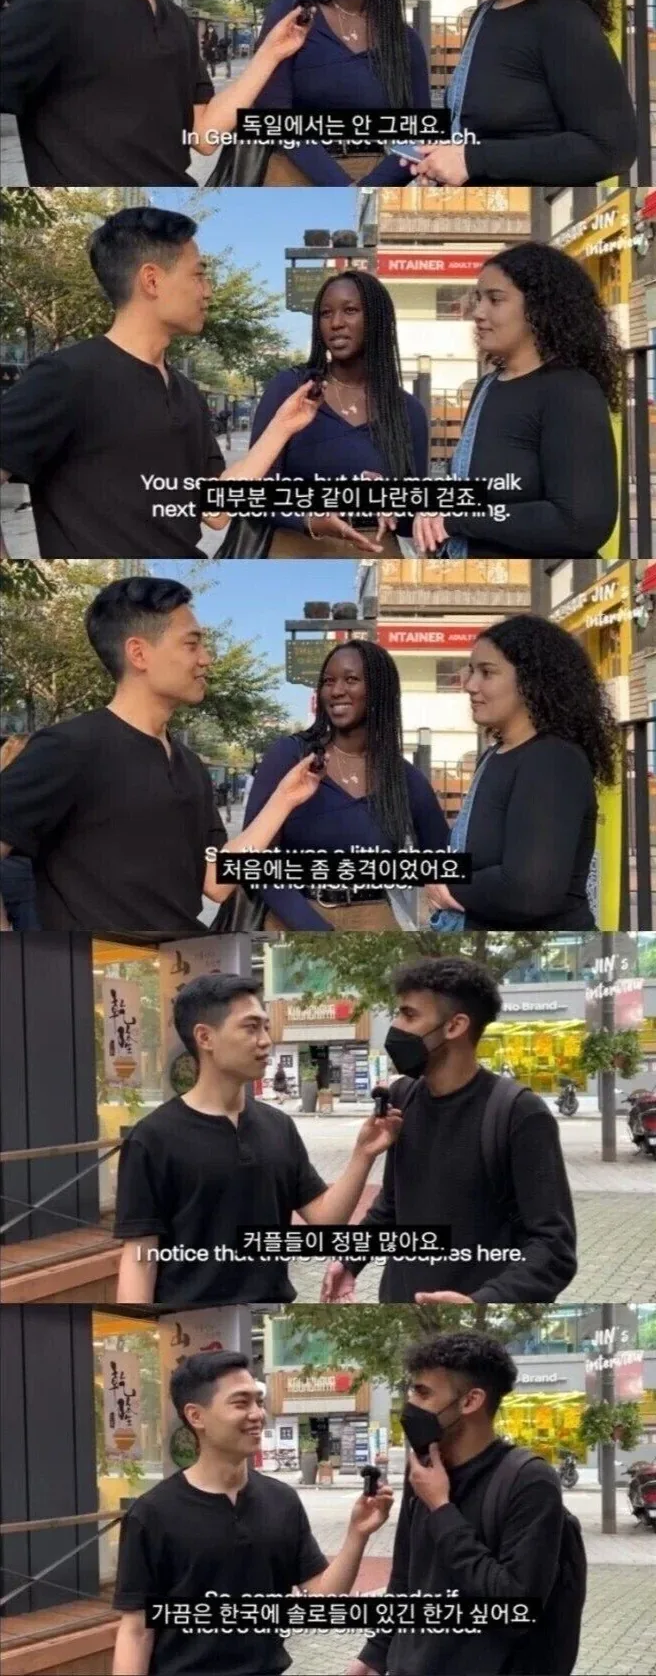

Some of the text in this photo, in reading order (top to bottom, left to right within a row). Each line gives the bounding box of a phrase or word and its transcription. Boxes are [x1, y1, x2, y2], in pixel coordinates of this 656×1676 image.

[503, 1001, 558, 1012] No Brand
[522, 1373, 558, 1383] Brand
